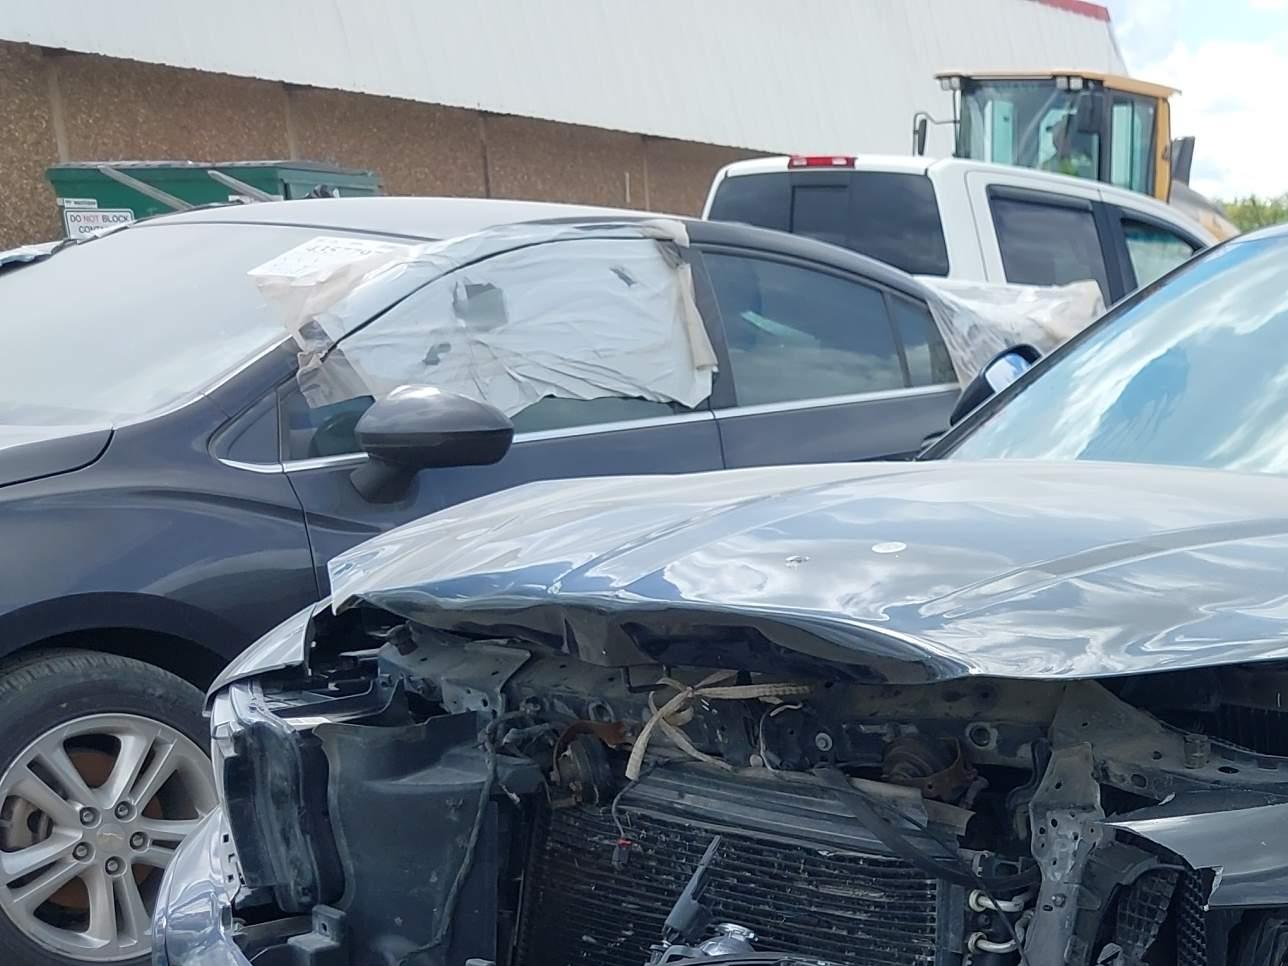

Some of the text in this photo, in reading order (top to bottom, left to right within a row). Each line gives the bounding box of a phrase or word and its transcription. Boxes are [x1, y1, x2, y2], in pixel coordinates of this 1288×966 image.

[70, 214, 129, 223] DO NOT BLOCK
